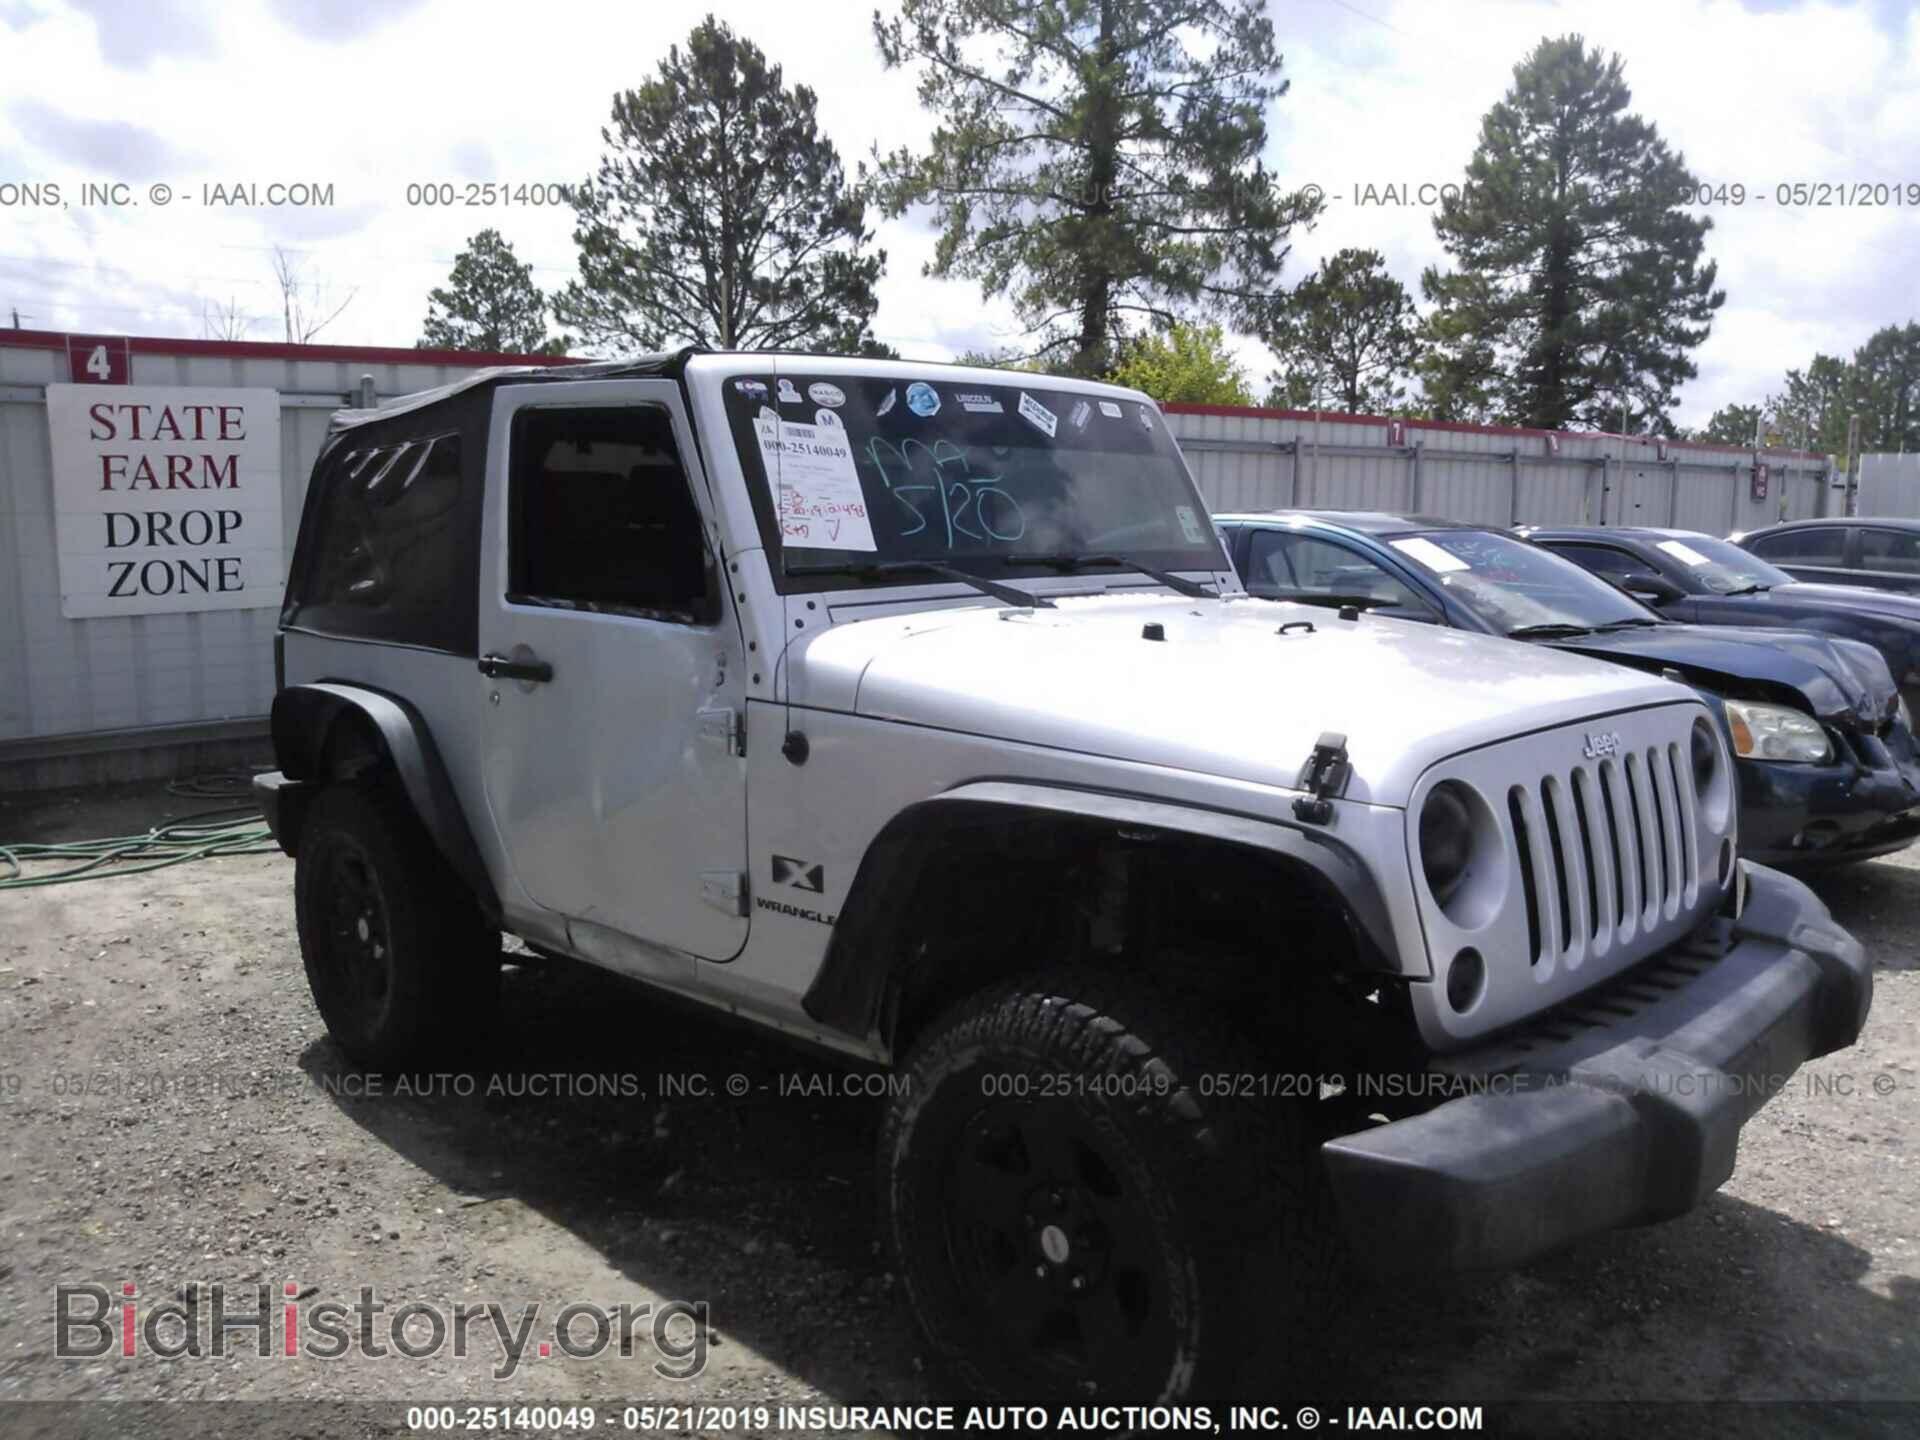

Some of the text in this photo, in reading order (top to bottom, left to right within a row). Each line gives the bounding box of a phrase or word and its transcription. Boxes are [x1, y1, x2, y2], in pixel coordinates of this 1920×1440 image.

[87, 345, 111, 380] 4
[89, 404, 247, 441] STATE
[763, 439, 848, 458] 000-25140049
[99, 454, 241, 491] FARM
[104, 510, 243, 548] DROP
[107, 557, 244, 597] ZONE
[1583, 732, 1619, 760] Jeep
